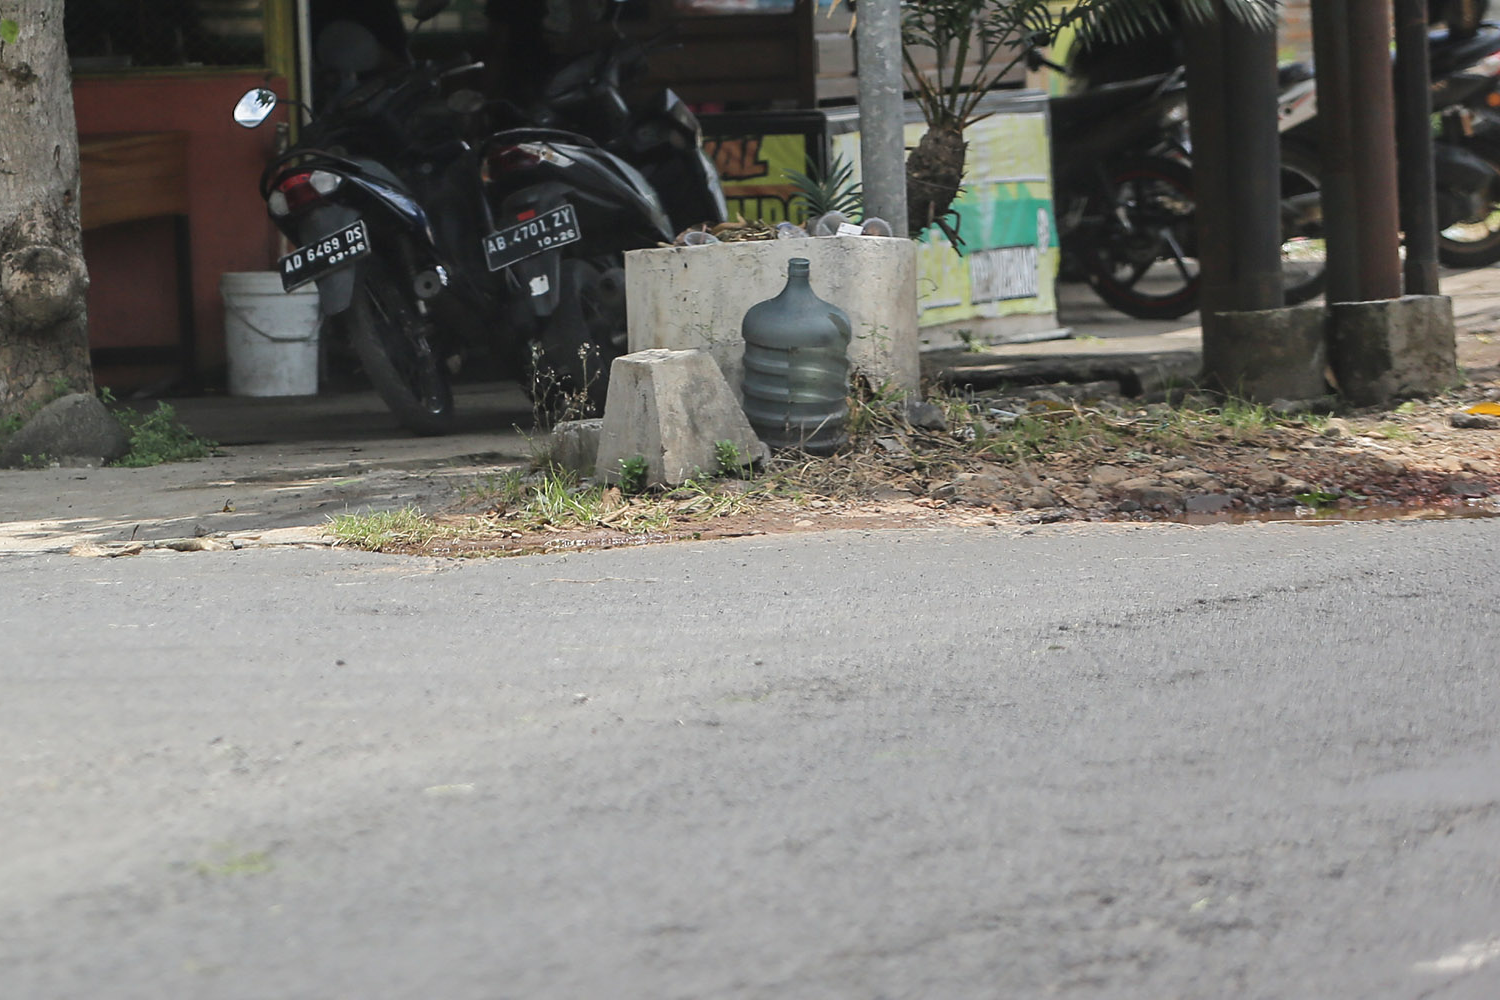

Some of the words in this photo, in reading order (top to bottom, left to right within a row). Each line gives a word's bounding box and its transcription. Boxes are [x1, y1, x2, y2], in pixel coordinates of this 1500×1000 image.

[285, 254, 302, 273] AD
[306, 237, 340, 261] 6469
[345, 226, 363, 243] DS
[487, 236, 506, 254] AB
[513, 220, 546, 242] 4701
[551, 208, 570, 227] ZY
